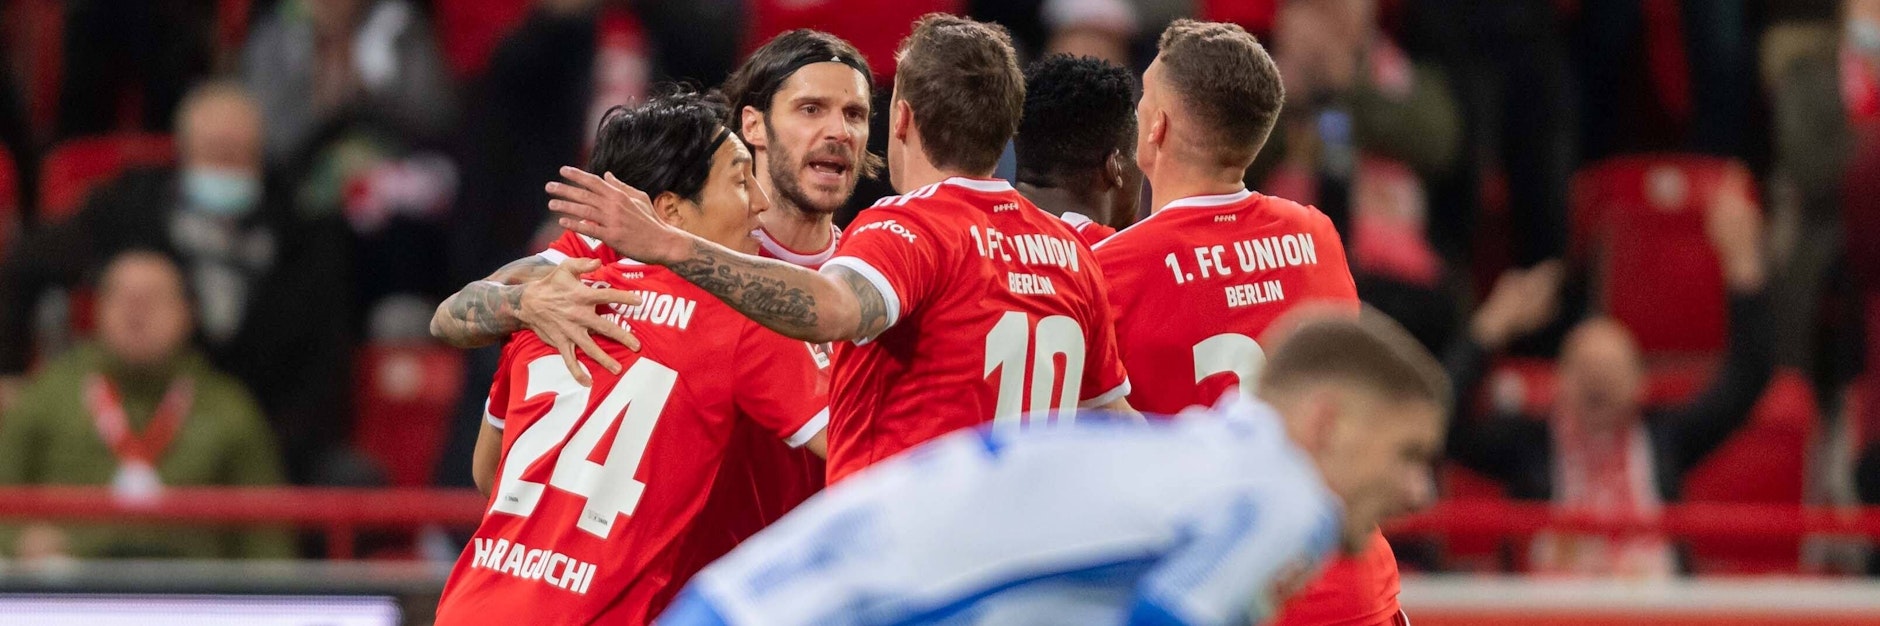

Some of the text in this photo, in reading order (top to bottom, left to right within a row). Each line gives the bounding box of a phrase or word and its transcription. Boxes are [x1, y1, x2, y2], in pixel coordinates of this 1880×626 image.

[986, 227, 1012, 262] FC
[1006, 233, 1079, 272] UNION
[1165, 232, 1317, 284] 1. FC UNION
[1008, 271, 1056, 295] BERLIN
[1225, 279, 1284, 308] BERLIN
[983, 310, 1085, 431] 10
[488, 354, 679, 539] 24
